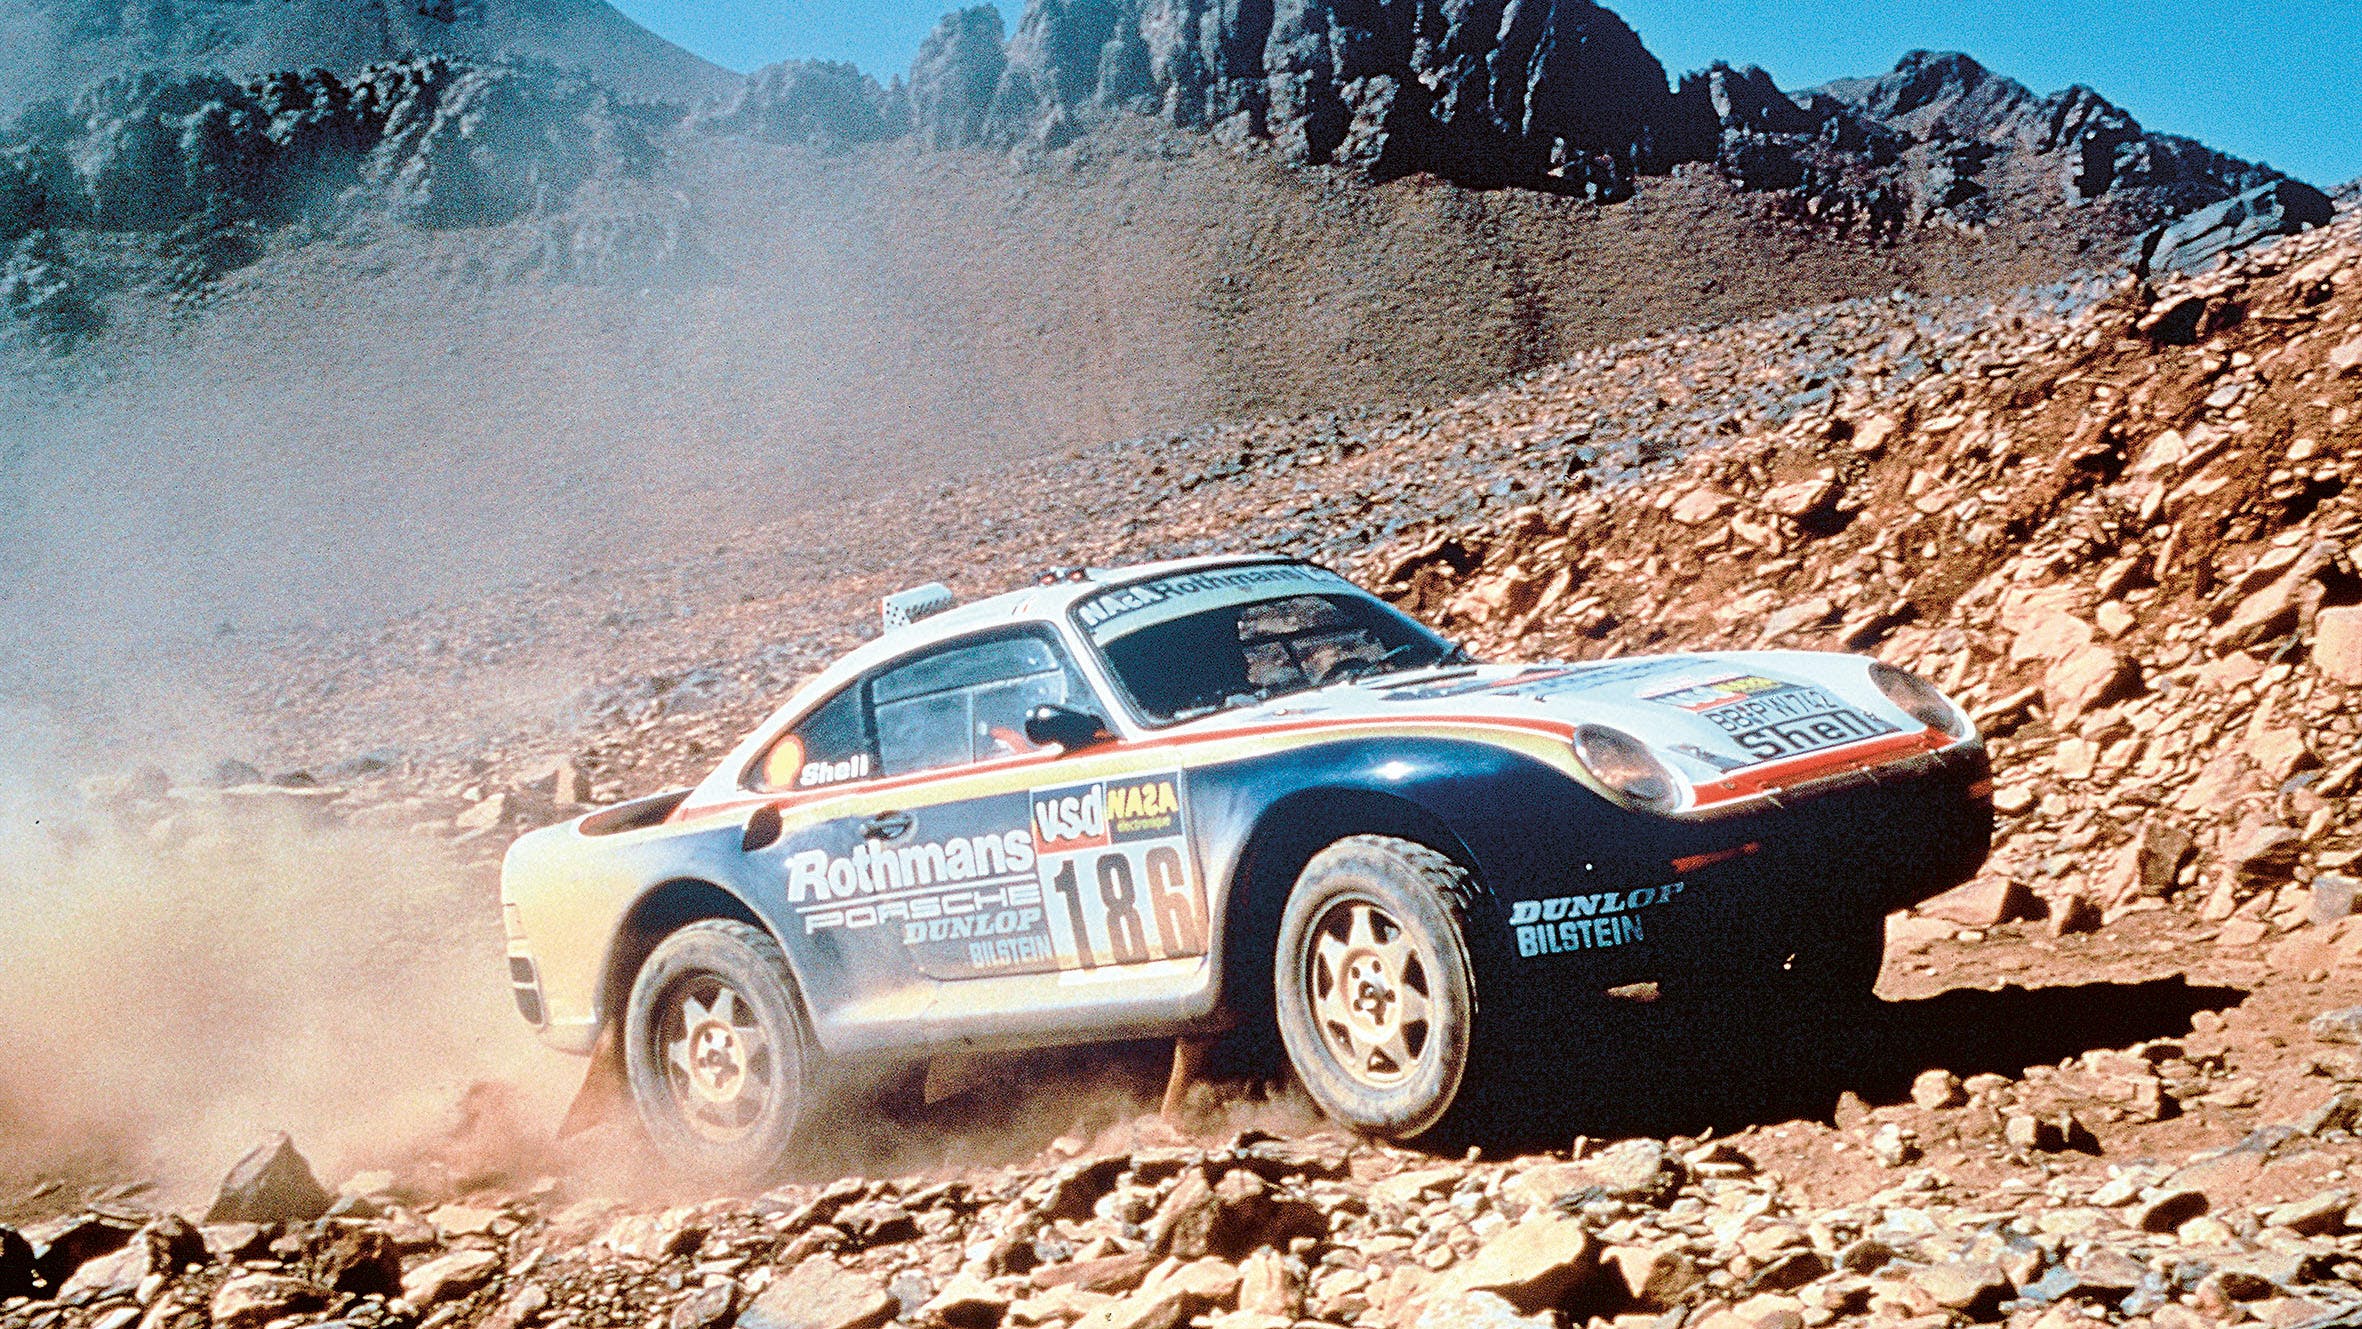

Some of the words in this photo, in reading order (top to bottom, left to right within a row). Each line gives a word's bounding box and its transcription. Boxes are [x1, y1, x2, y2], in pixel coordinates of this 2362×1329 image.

[1732, 709, 1878, 759] Shell
[800, 753, 868, 786] Shell
[785, 829, 1035, 901] Rothmans
[805, 883, 1042, 935] PORSCHE
[903, 907, 1042, 944] DUNLOP
[1054, 846, 1205, 970] 186
[1509, 881, 1685, 926] DUNLOP
[969, 934, 1052, 968] BILSTEIN
[1516, 914, 1645, 958] BILSTEIN
